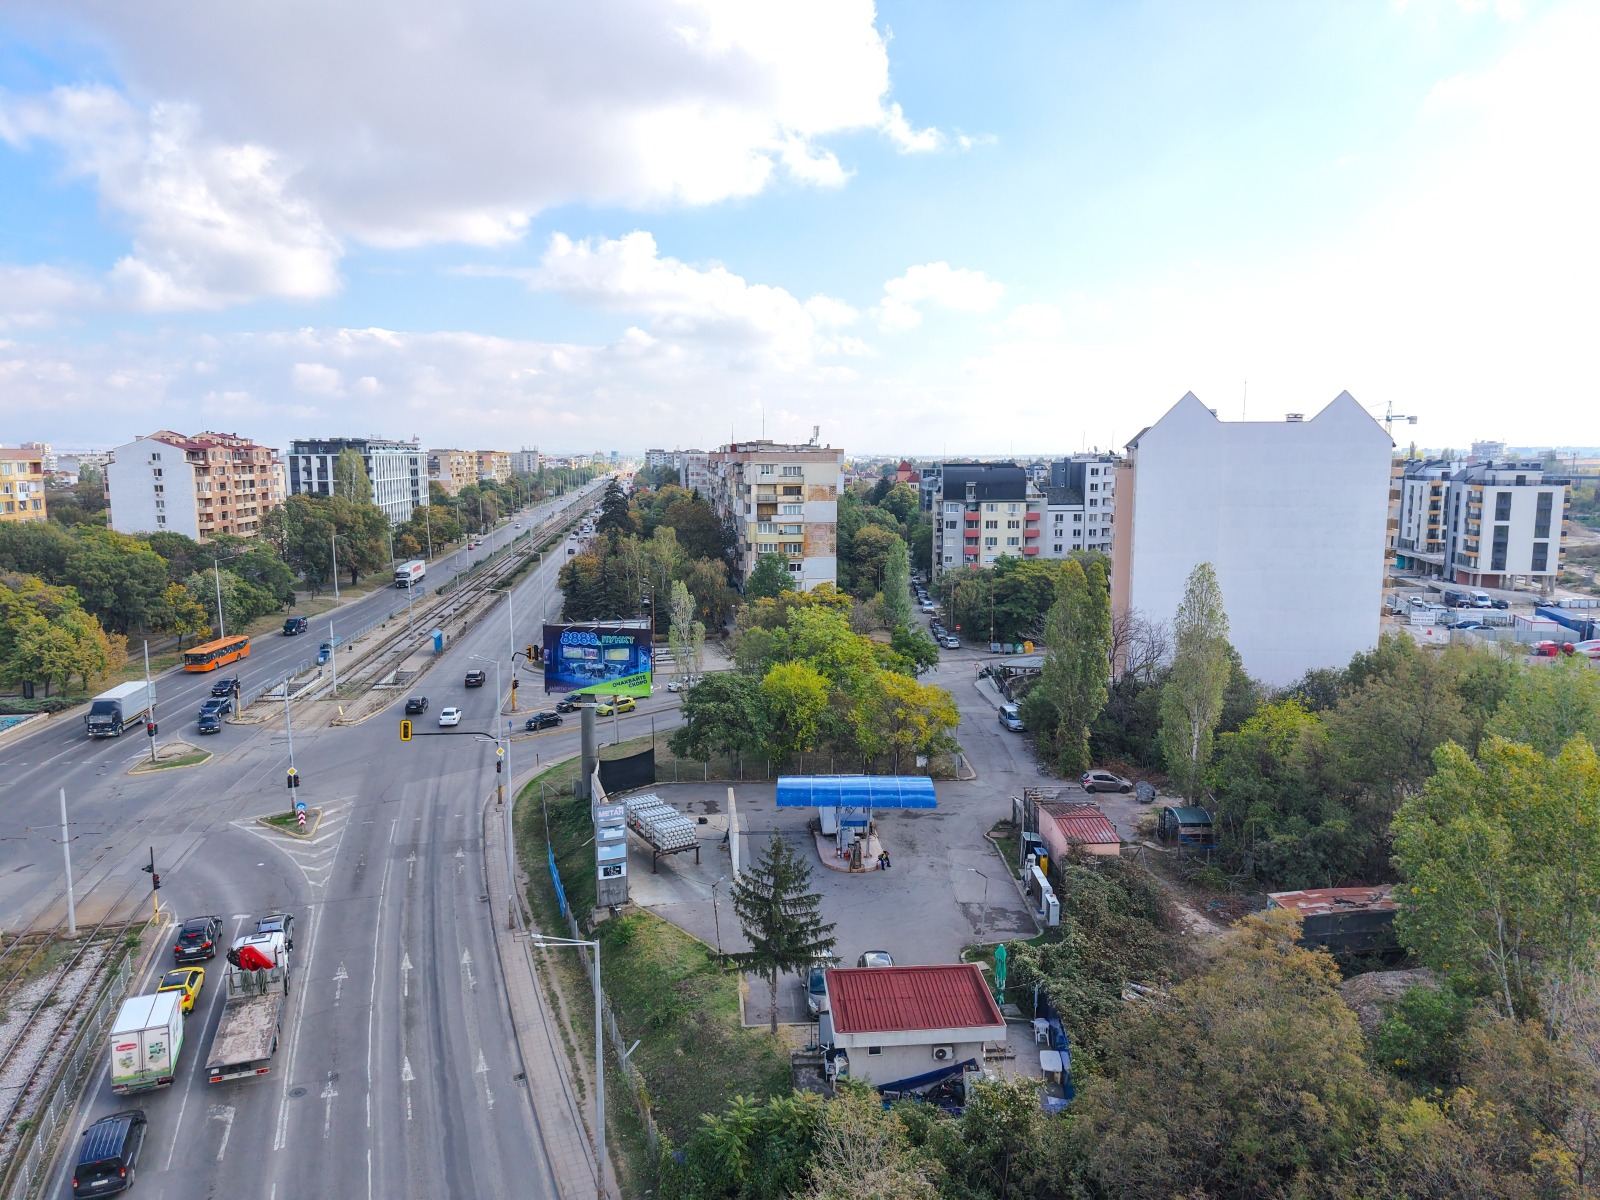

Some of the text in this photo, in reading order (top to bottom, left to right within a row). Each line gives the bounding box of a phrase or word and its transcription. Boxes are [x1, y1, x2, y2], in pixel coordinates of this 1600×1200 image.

[601, 635, 635, 644] ПУНКТ
[612, 675, 646, 687] ОЧАКВАЙТЕ
[628, 680, 648, 688] СКОРО
[598, 809, 624, 817] МЕТАН
